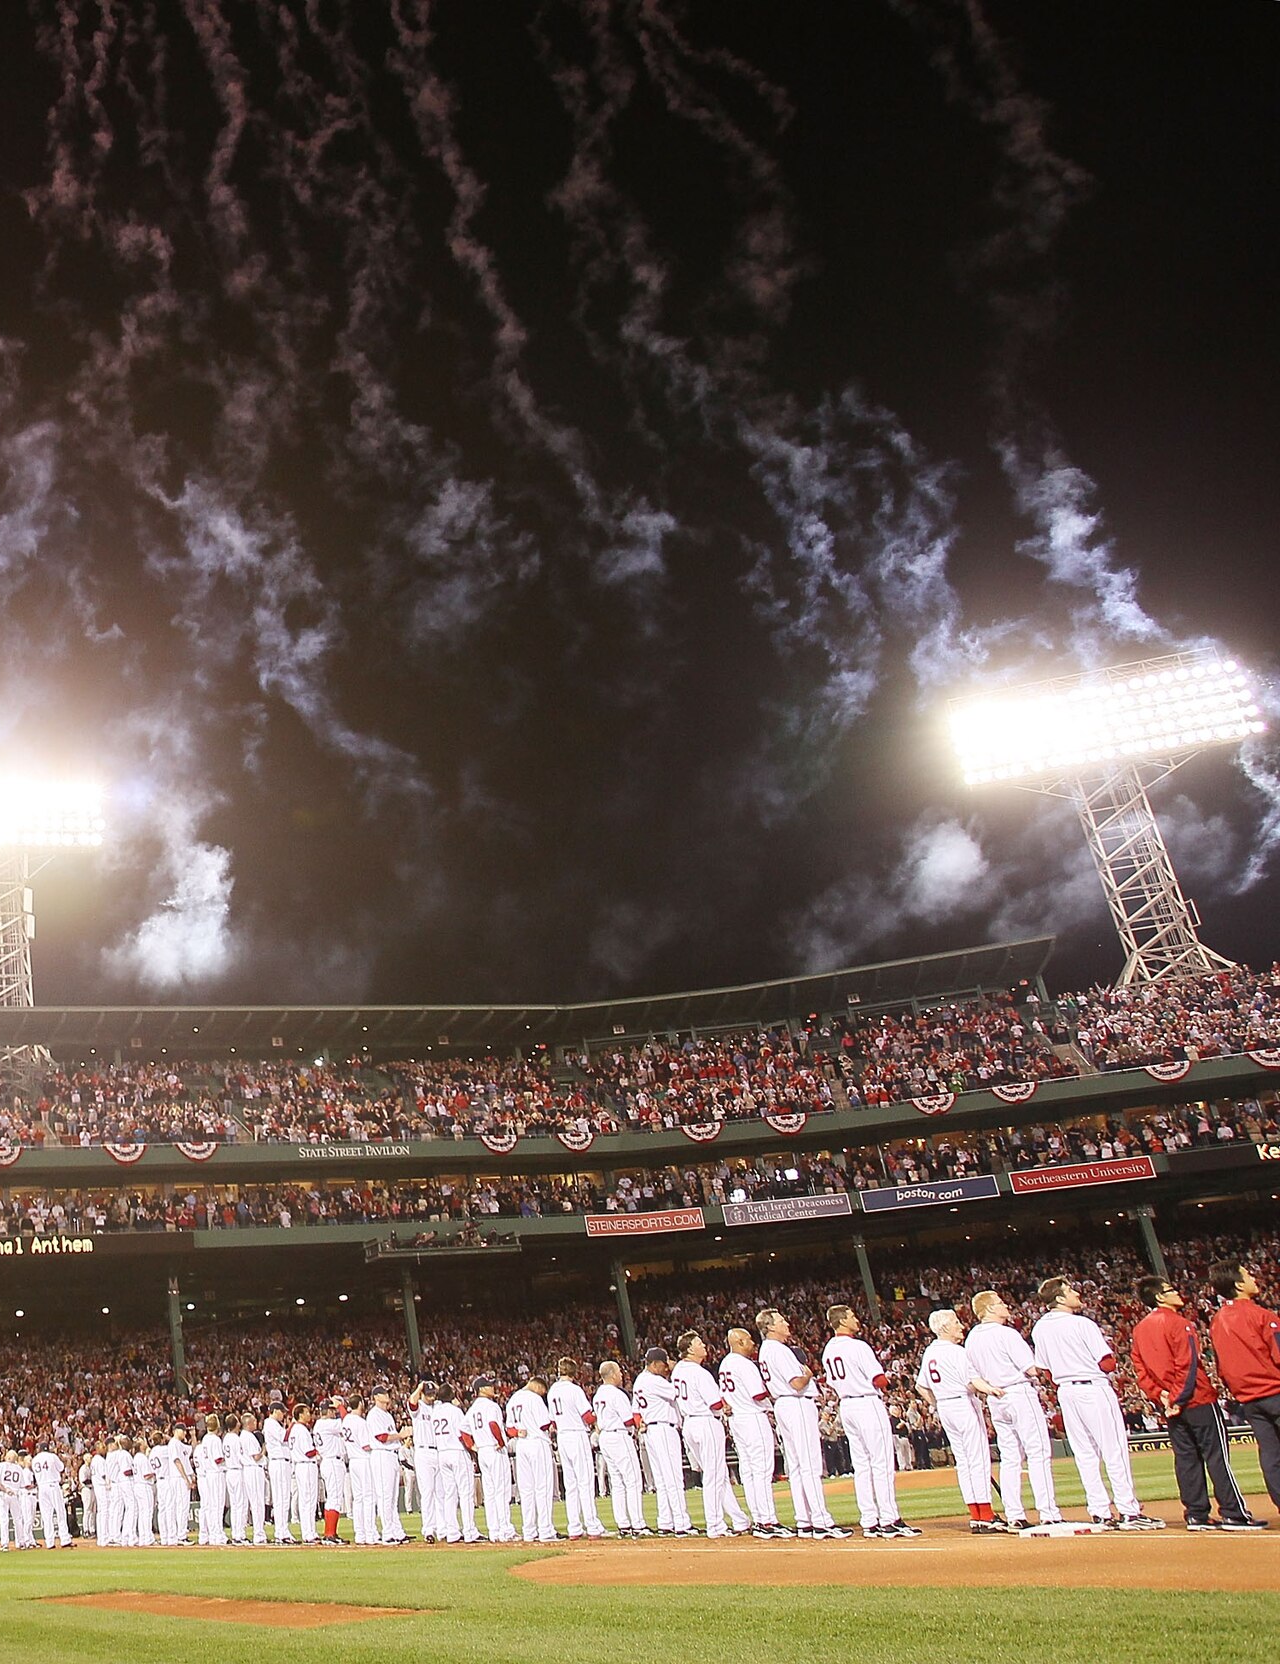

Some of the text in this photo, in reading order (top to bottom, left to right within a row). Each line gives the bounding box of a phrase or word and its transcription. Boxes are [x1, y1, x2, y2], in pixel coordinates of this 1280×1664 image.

[298, 1146, 328, 1158] STATE
[365, 1145, 410, 1157] PAVILION
[1017, 1160, 1147, 1188] Northeastern University
[746, 1197, 844, 1214] Beth Israel Deaconess
[587, 1213, 702, 1232] STEINERSPORTS.COM
[748, 1208, 818, 1222] Medical Center
[31, 1237, 94, 1255] Anthem
[826, 1356, 846, 1381] 10
[928, 1359, 942, 1383] 6
[472, 1411, 483, 1430] 18
[511, 1404, 522, 1423] 17
[433, 1418, 450, 1436] 22
[34, 1461, 49, 1473] 34
[3, 1470, 20, 1483] 20
